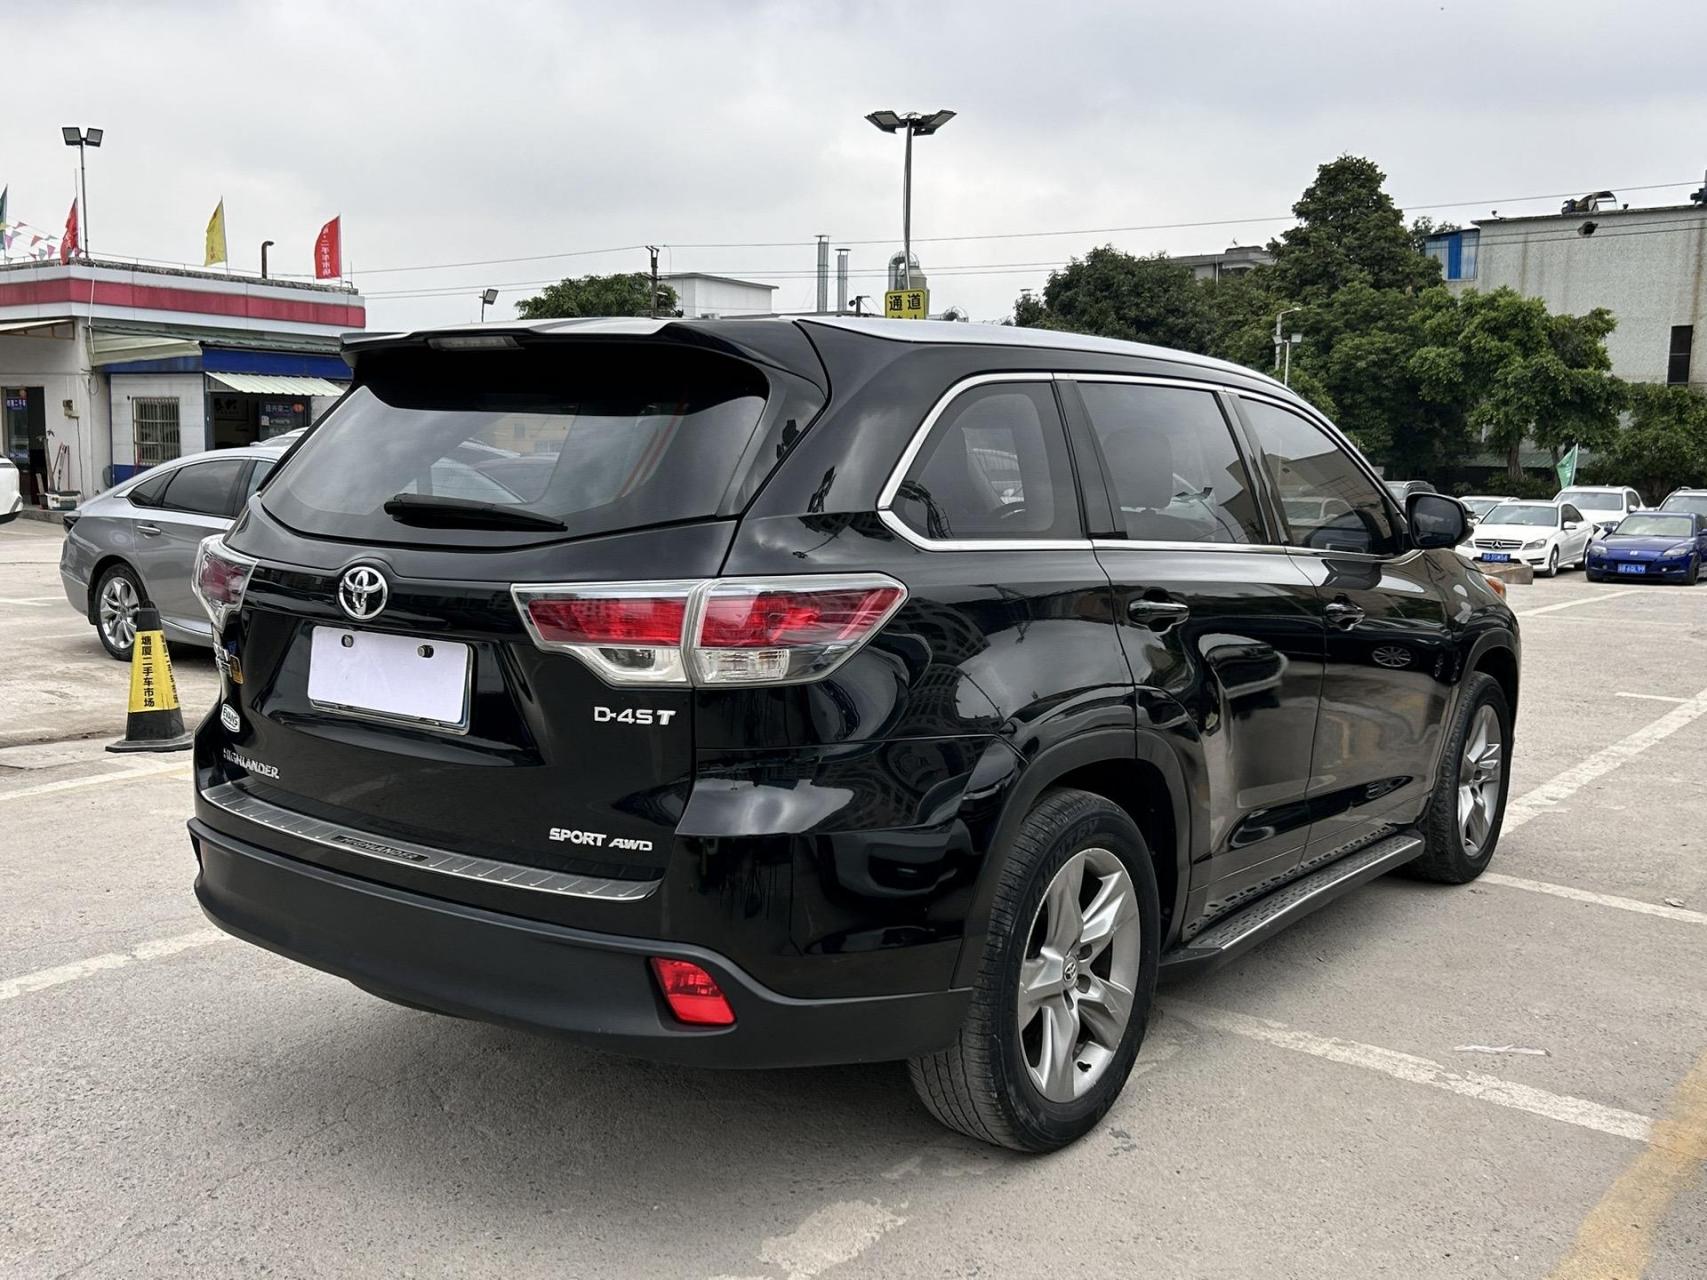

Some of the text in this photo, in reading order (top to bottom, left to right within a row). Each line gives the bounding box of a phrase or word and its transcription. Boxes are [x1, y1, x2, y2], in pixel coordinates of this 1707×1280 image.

[889, 293, 921, 311] 通道
[223, 748, 280, 780] HIGHLANDER
[548, 827, 653, 851] SPORT AWD
